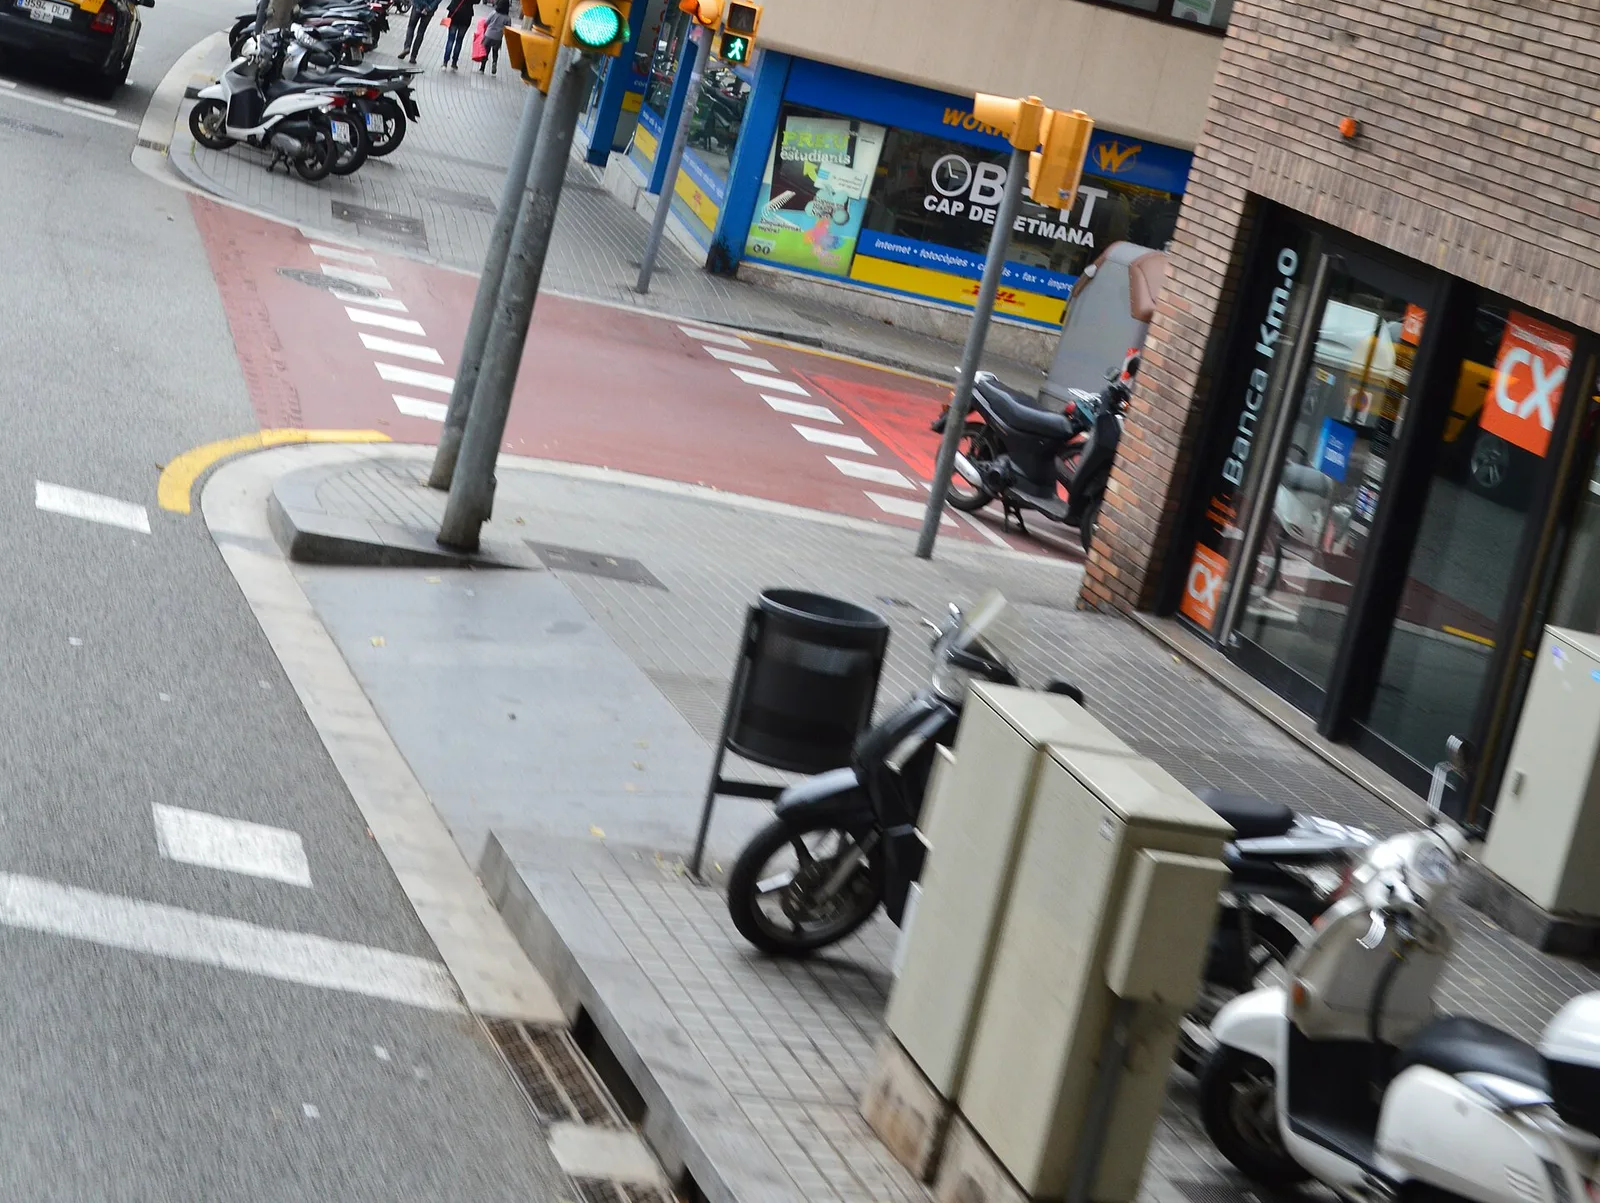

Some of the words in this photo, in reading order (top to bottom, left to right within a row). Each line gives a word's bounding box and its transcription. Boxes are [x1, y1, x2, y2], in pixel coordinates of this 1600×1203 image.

[923, 195, 965, 217] CAP
[968, 207, 996, 225] DE
[1012, 216, 1095, 248] ETMANA
[931, 154, 1109, 229] OBT
[875, 238, 911, 256] internet
[1022, 271, 1037, 284] fax
[1496, 347, 1568, 431] CX
[1222, 368, 1269, 487] Banca
[1188, 562, 1222, 611] CX
